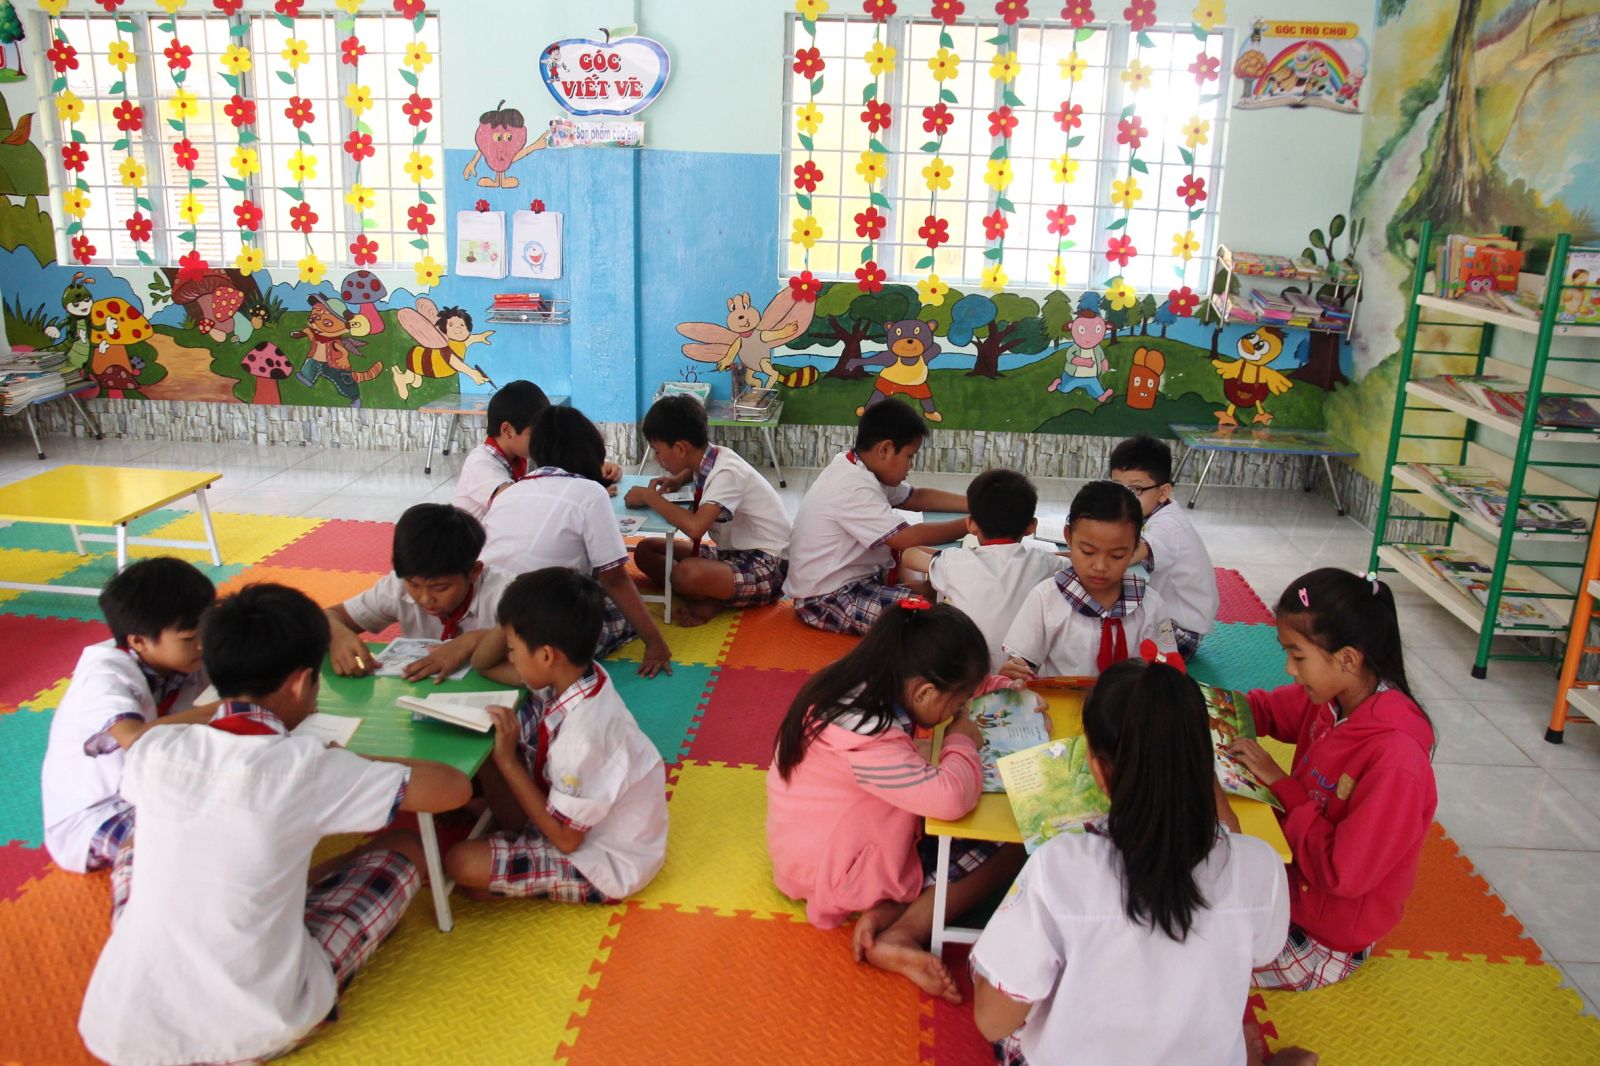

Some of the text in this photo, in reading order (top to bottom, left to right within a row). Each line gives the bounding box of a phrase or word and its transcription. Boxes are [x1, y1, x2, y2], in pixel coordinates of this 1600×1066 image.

[1275, 23, 1297, 34] GÓC
[579, 50, 621, 72] GÓC
[561, 74, 643, 99] VIẾT VẼ
